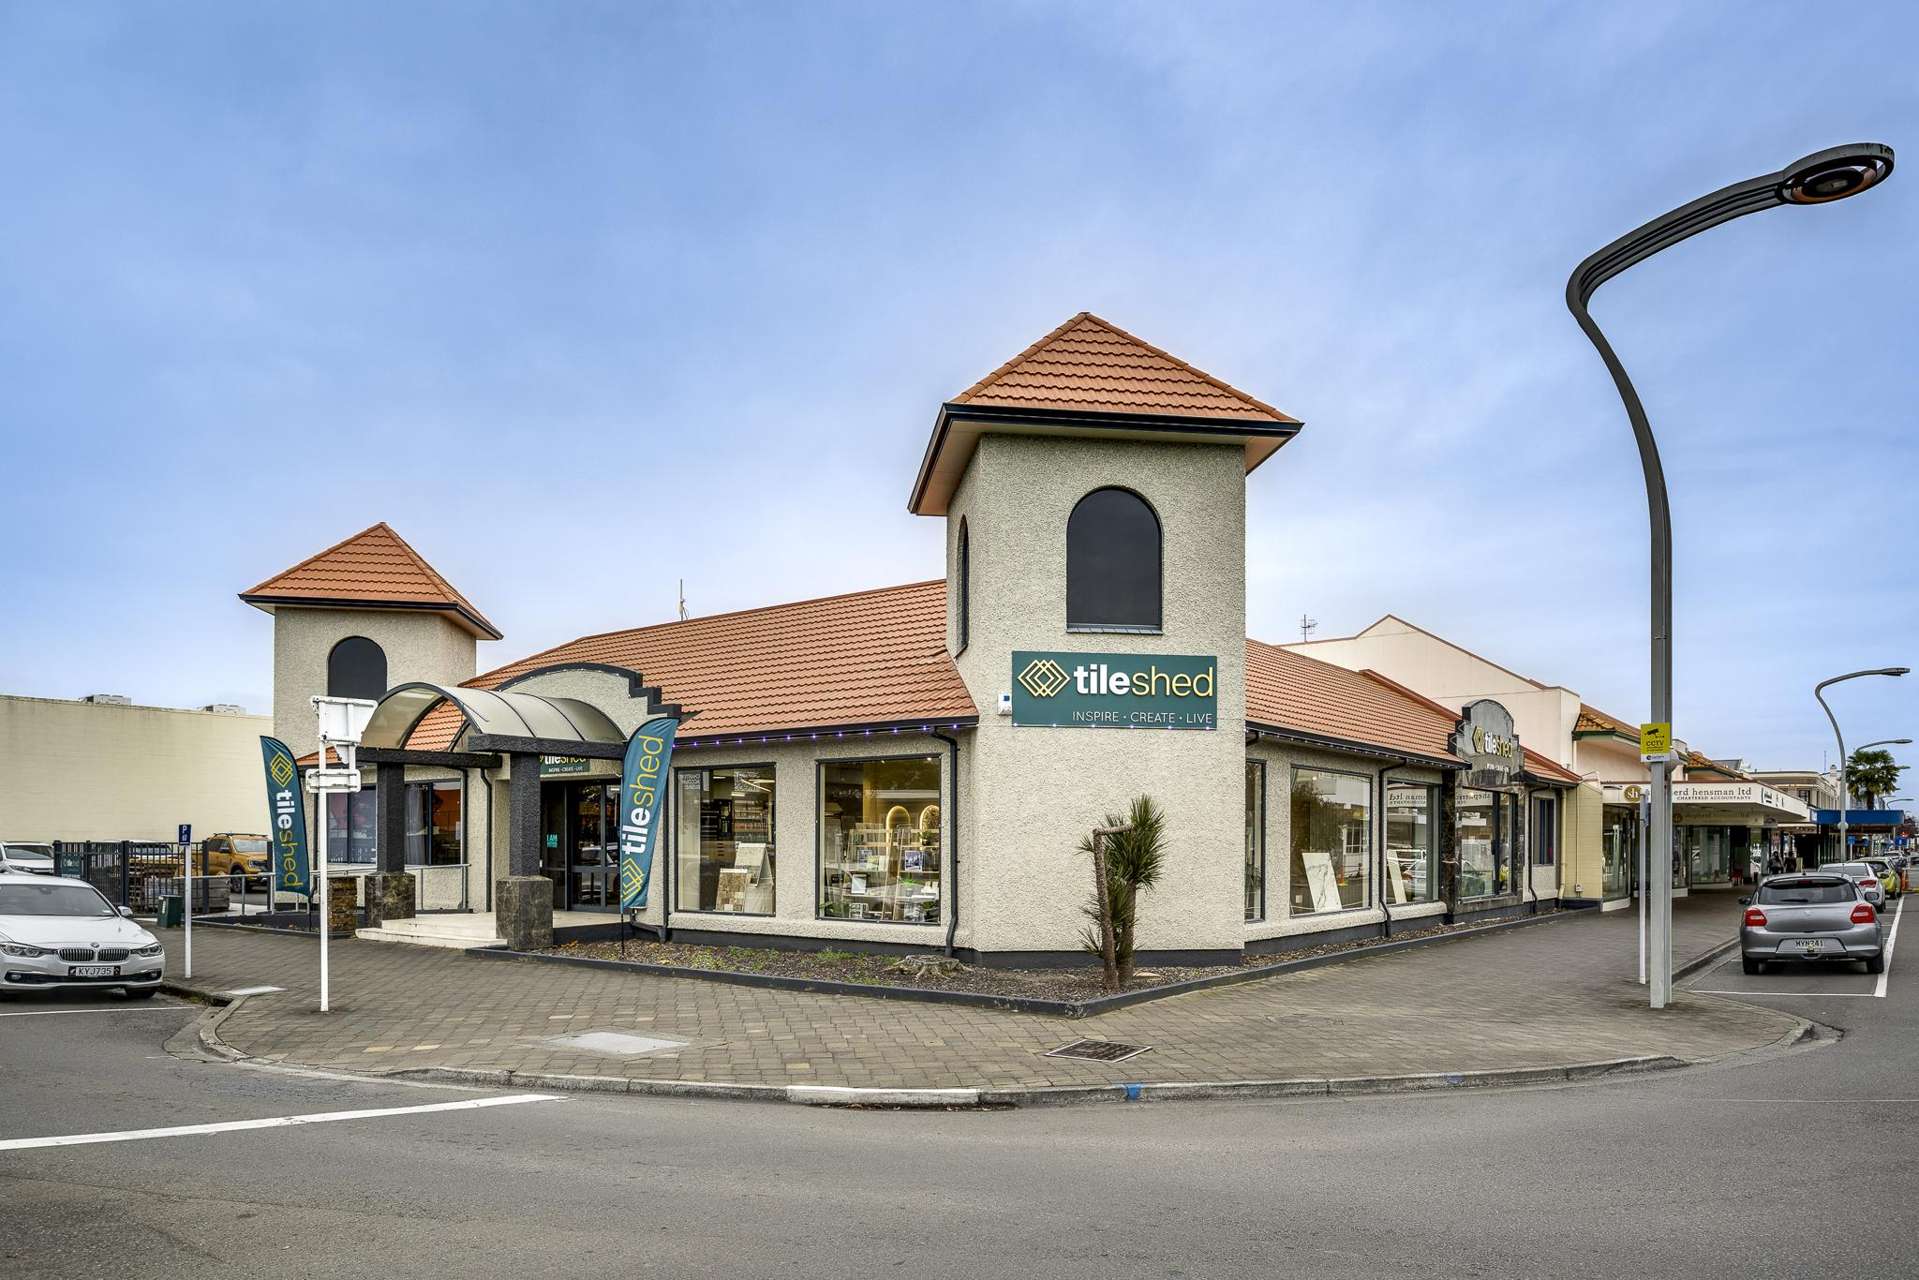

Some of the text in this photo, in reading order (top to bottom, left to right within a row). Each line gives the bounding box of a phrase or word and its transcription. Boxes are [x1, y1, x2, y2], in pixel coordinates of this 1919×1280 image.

[1073, 663, 1213, 697] tileshed
[1072, 711, 1213, 724] INSPIRE CREATE LIVE
[621, 735, 664, 855] tileshed
[1692, 787, 1734, 796] hensman
[1738, 786, 1752, 796] ltd
[276, 789, 304, 887] tileshed
